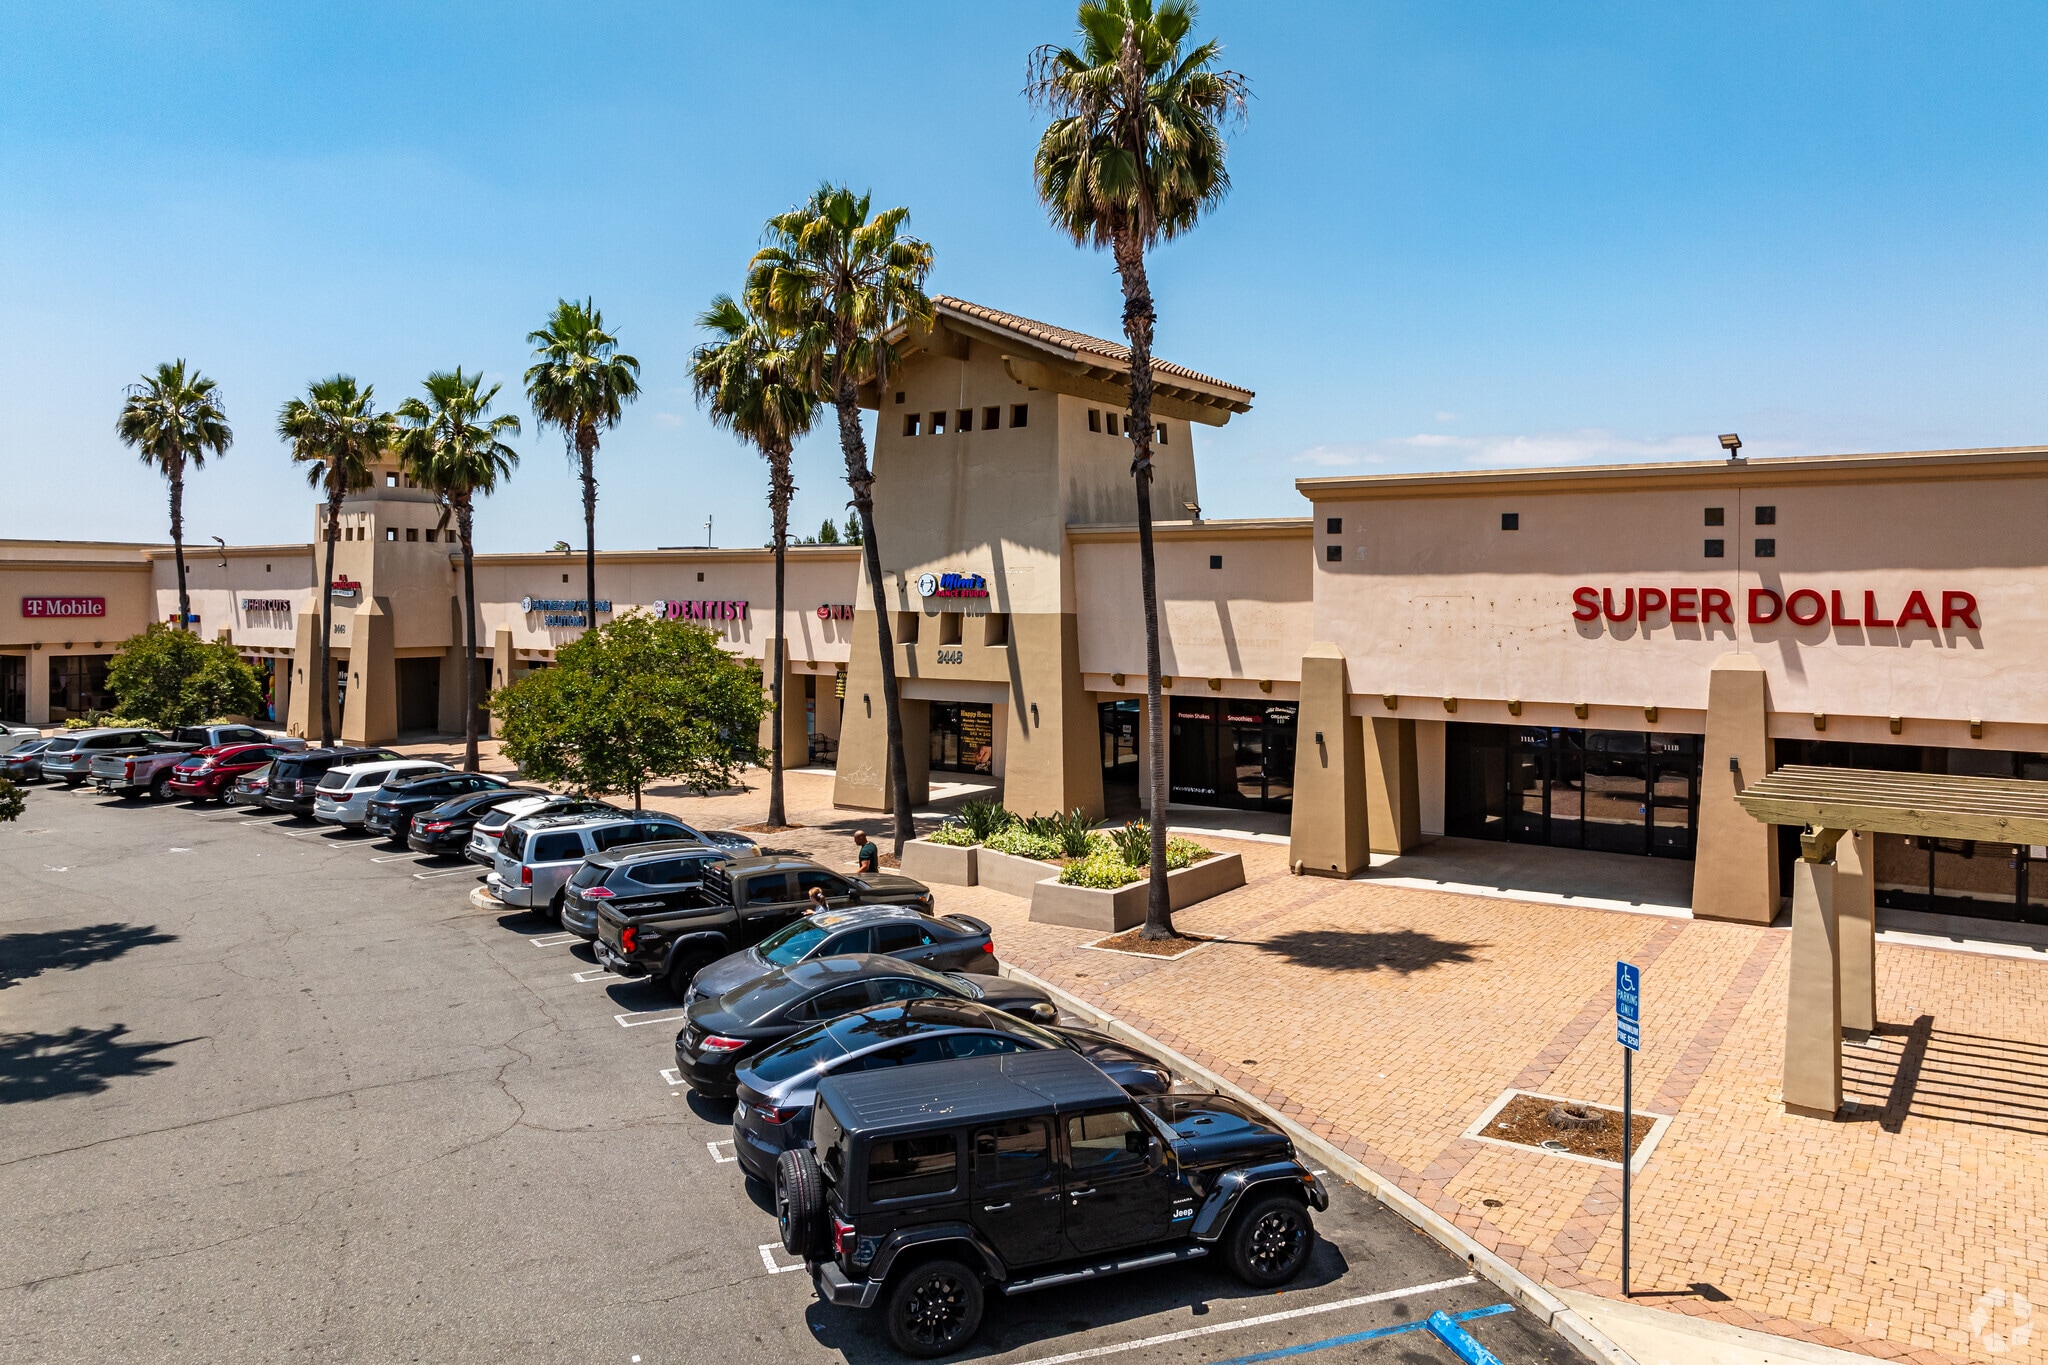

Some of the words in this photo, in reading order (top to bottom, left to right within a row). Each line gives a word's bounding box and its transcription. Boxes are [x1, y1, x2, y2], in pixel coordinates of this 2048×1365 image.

[940, 573, 986, 591] Mimi's
[935, 589, 959, 598] DANCE
[960, 589, 988, 598] STUDIO
[45, 599, 103, 615] Mobile
[248, 599, 267, 611] HAIR
[267, 599, 289, 611] CUTS
[531, 599, 577, 611] PARTNERSHIP
[668, 600, 747, 621] DENTIST
[1571, 586, 1734, 625] SUPER
[1747, 588, 1979, 630] DOLLAR
[544, 614, 585, 627] SOLUTIONS
[936, 649, 963, 665] 2448
[1227, 714, 1253, 722] Smoothies
[1270, 713, 1290, 721] ORGANIC
[1520, 735, 1535, 743] 111A
[1663, 744, 1680, 752] 111B
[1617, 989, 1637, 1006] PARKING
[1621, 1003, 1633, 1016] ONLY
[1173, 1208, 1193, 1218] Jeep
